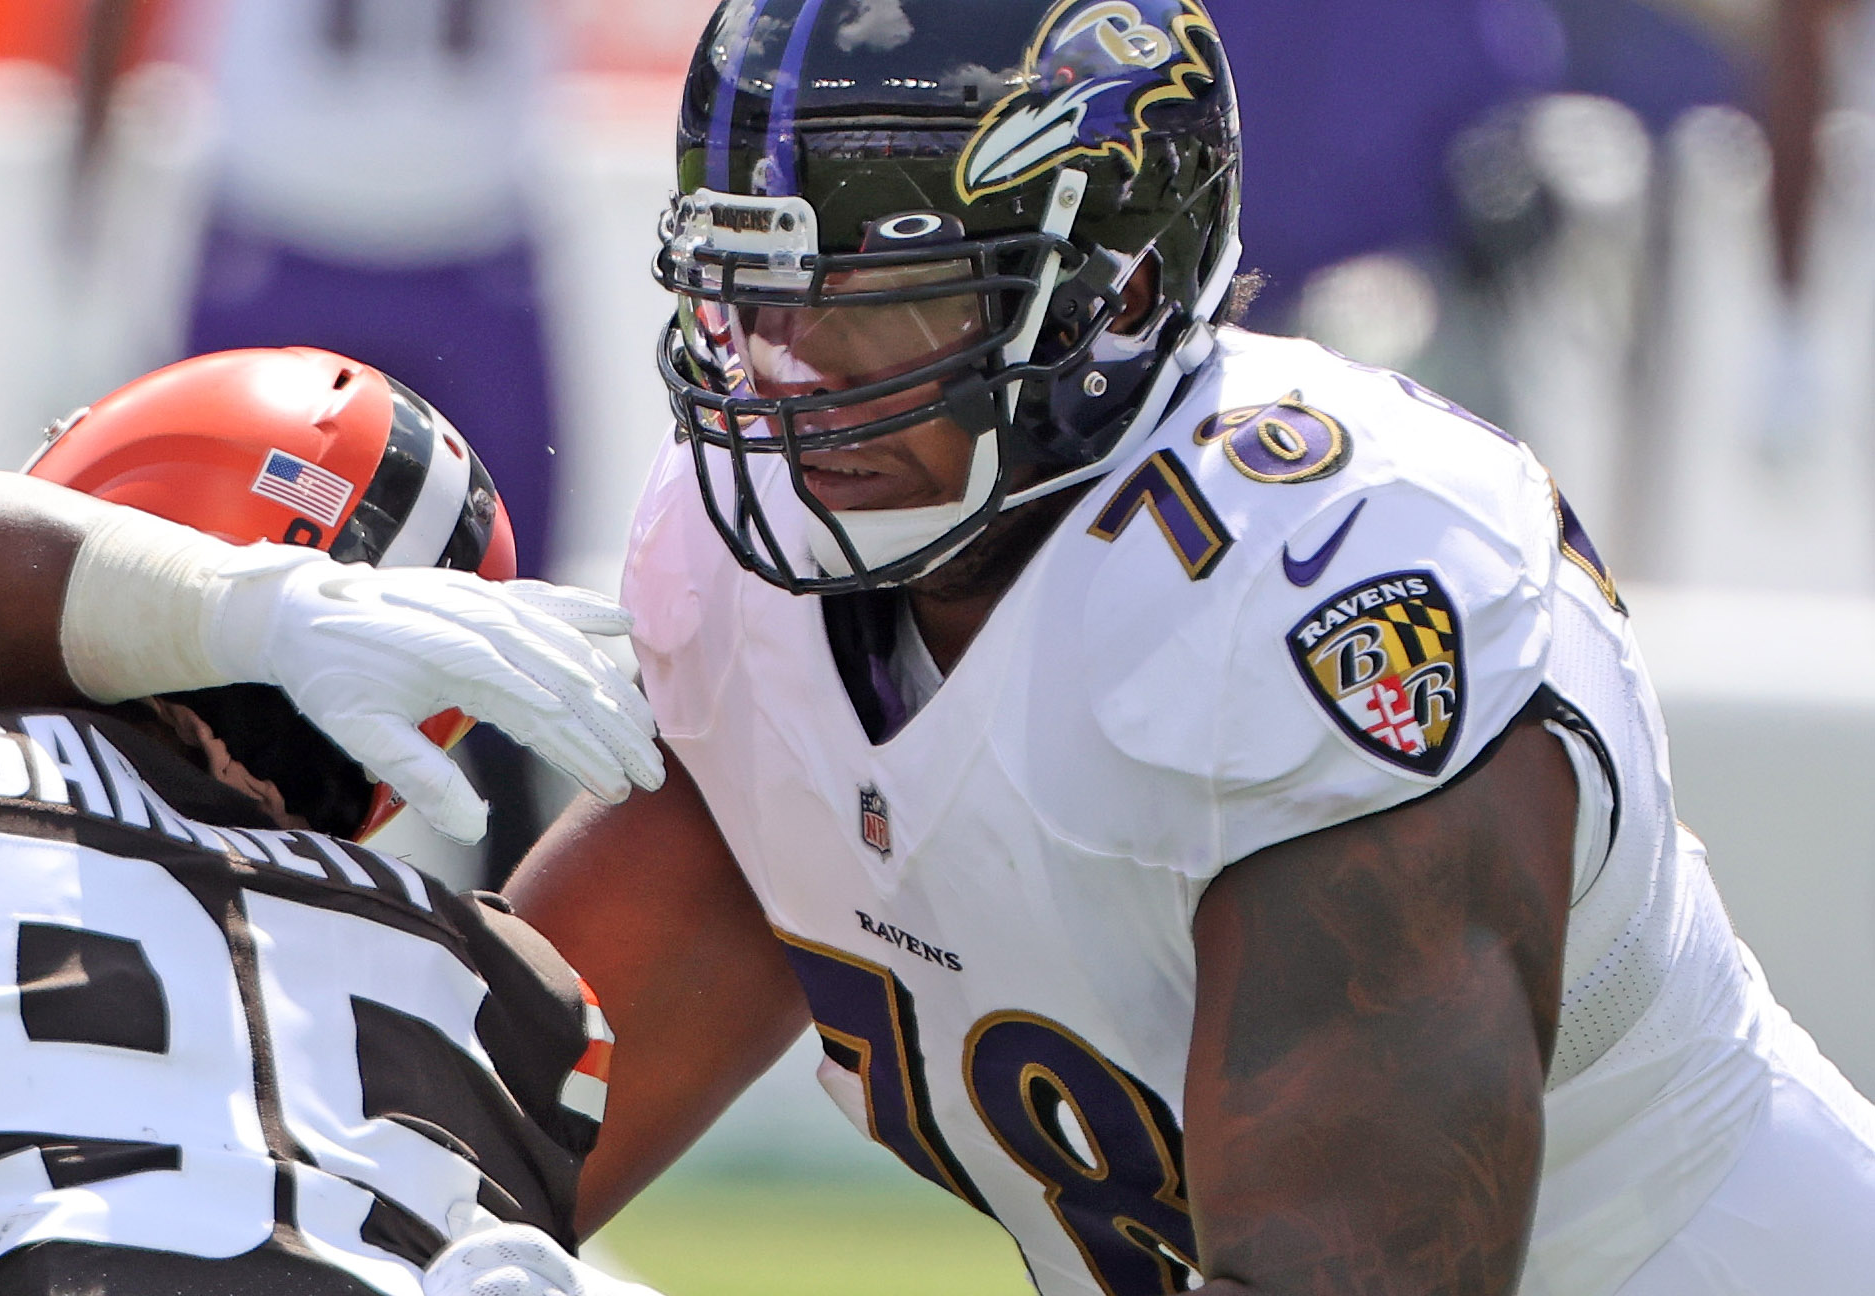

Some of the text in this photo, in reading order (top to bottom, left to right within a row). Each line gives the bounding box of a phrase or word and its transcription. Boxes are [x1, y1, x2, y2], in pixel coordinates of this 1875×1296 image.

[1086, 389, 1354, 583] 78
[1297, 577, 1429, 649] RAVENS
[1314, 622, 1389, 697] B
[854, 909, 964, 972] RAVENS
